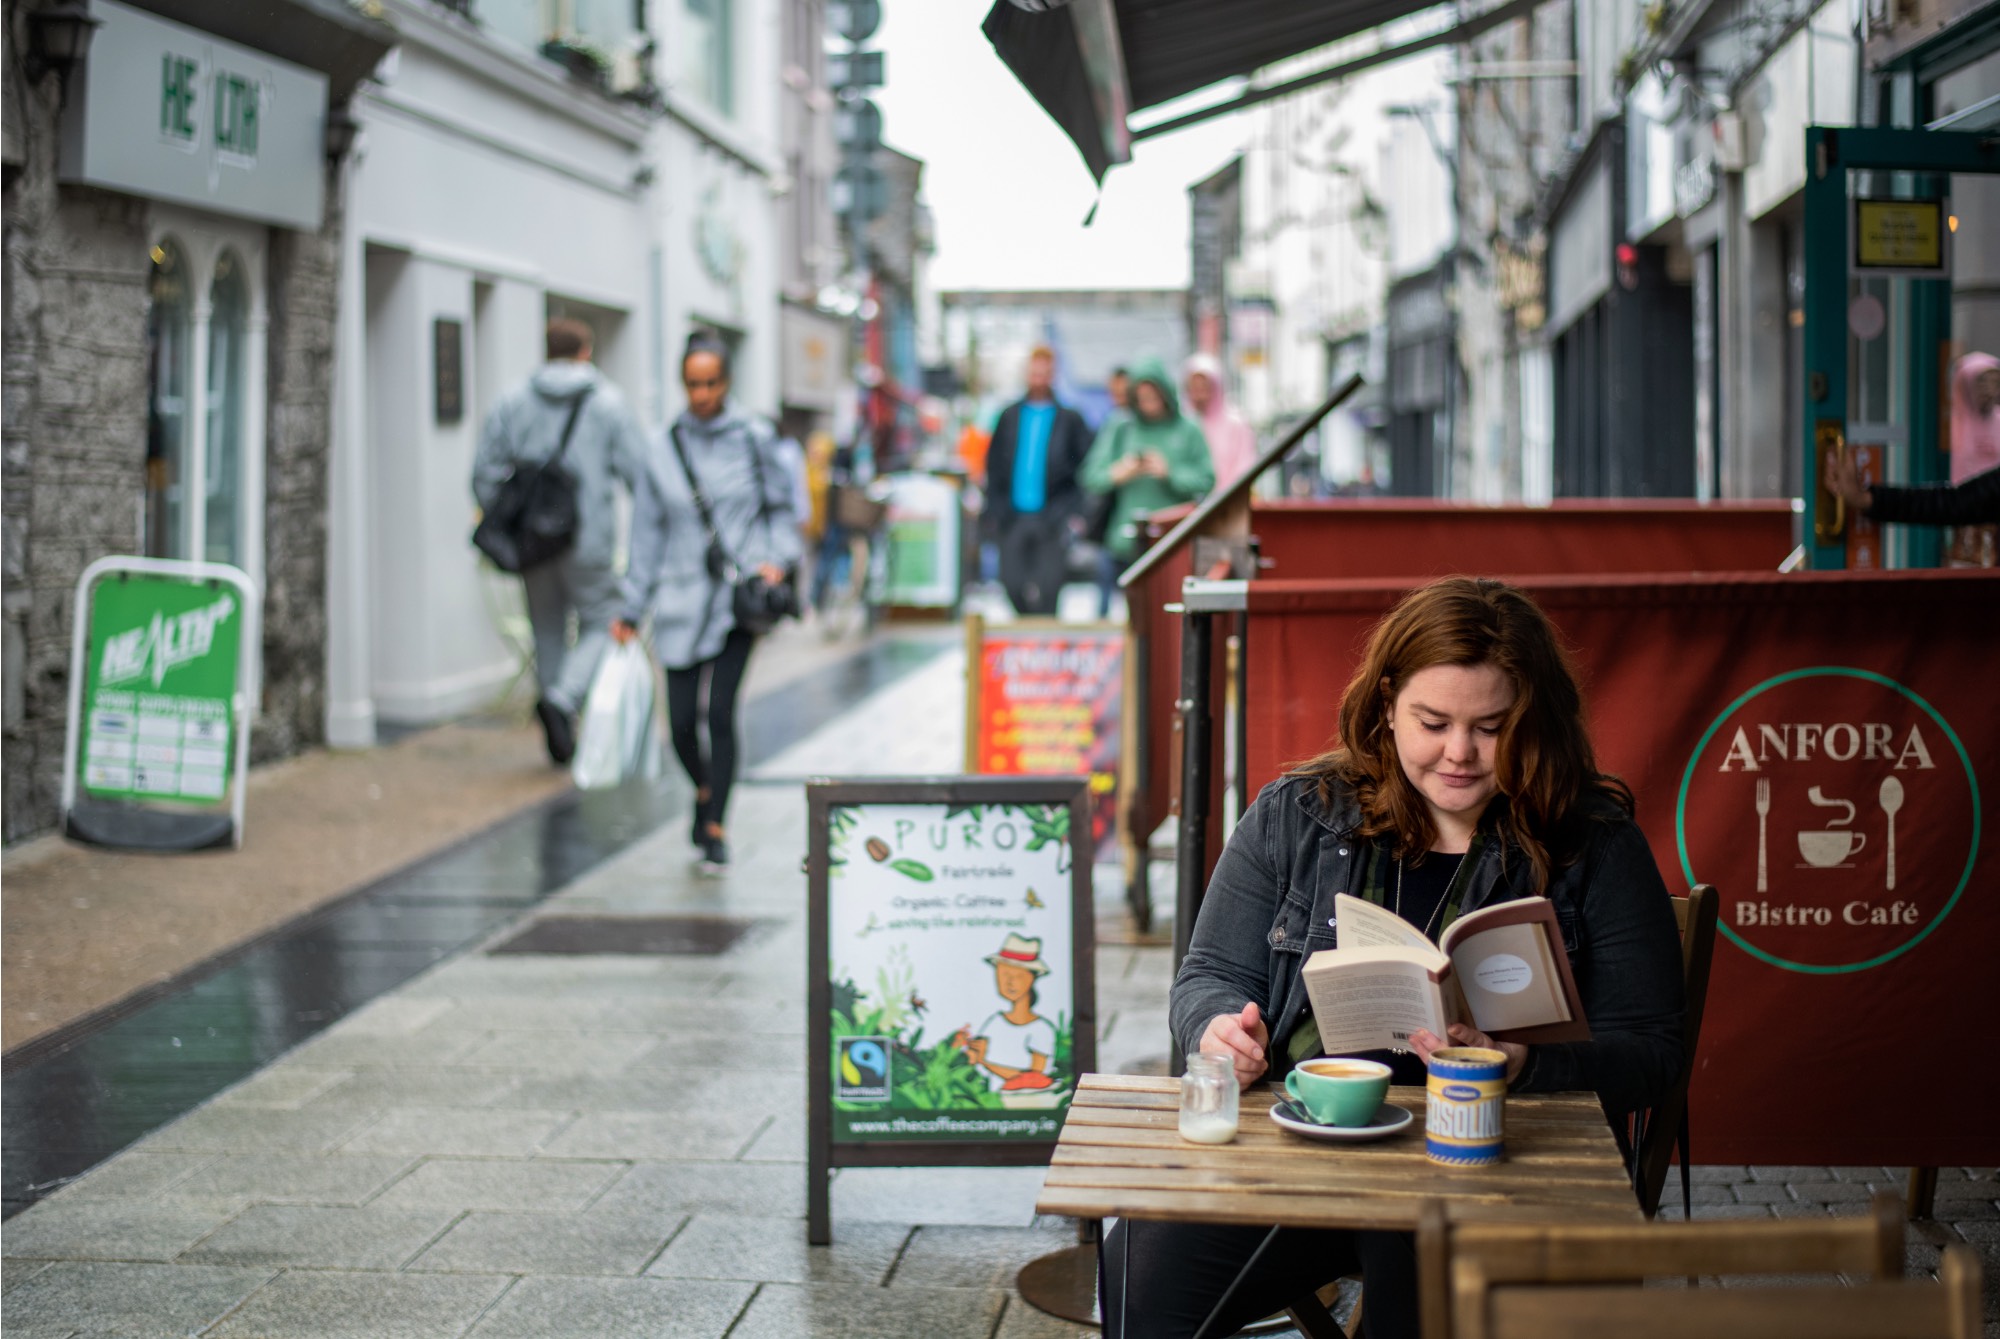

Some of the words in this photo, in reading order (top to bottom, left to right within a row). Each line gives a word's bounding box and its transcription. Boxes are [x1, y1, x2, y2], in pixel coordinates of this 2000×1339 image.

[1718, 722, 1936, 773] ANFORA
[895, 819, 1017, 851] PURO
[942, 864, 1014, 878] Fairtrade
[955, 893, 1006, 908] Coffee
[1735, 901, 1832, 926] Bistro
[1842, 900, 1919, 926] Café
[849, 1116, 1057, 1135] www.thecoffeecompany.ie
